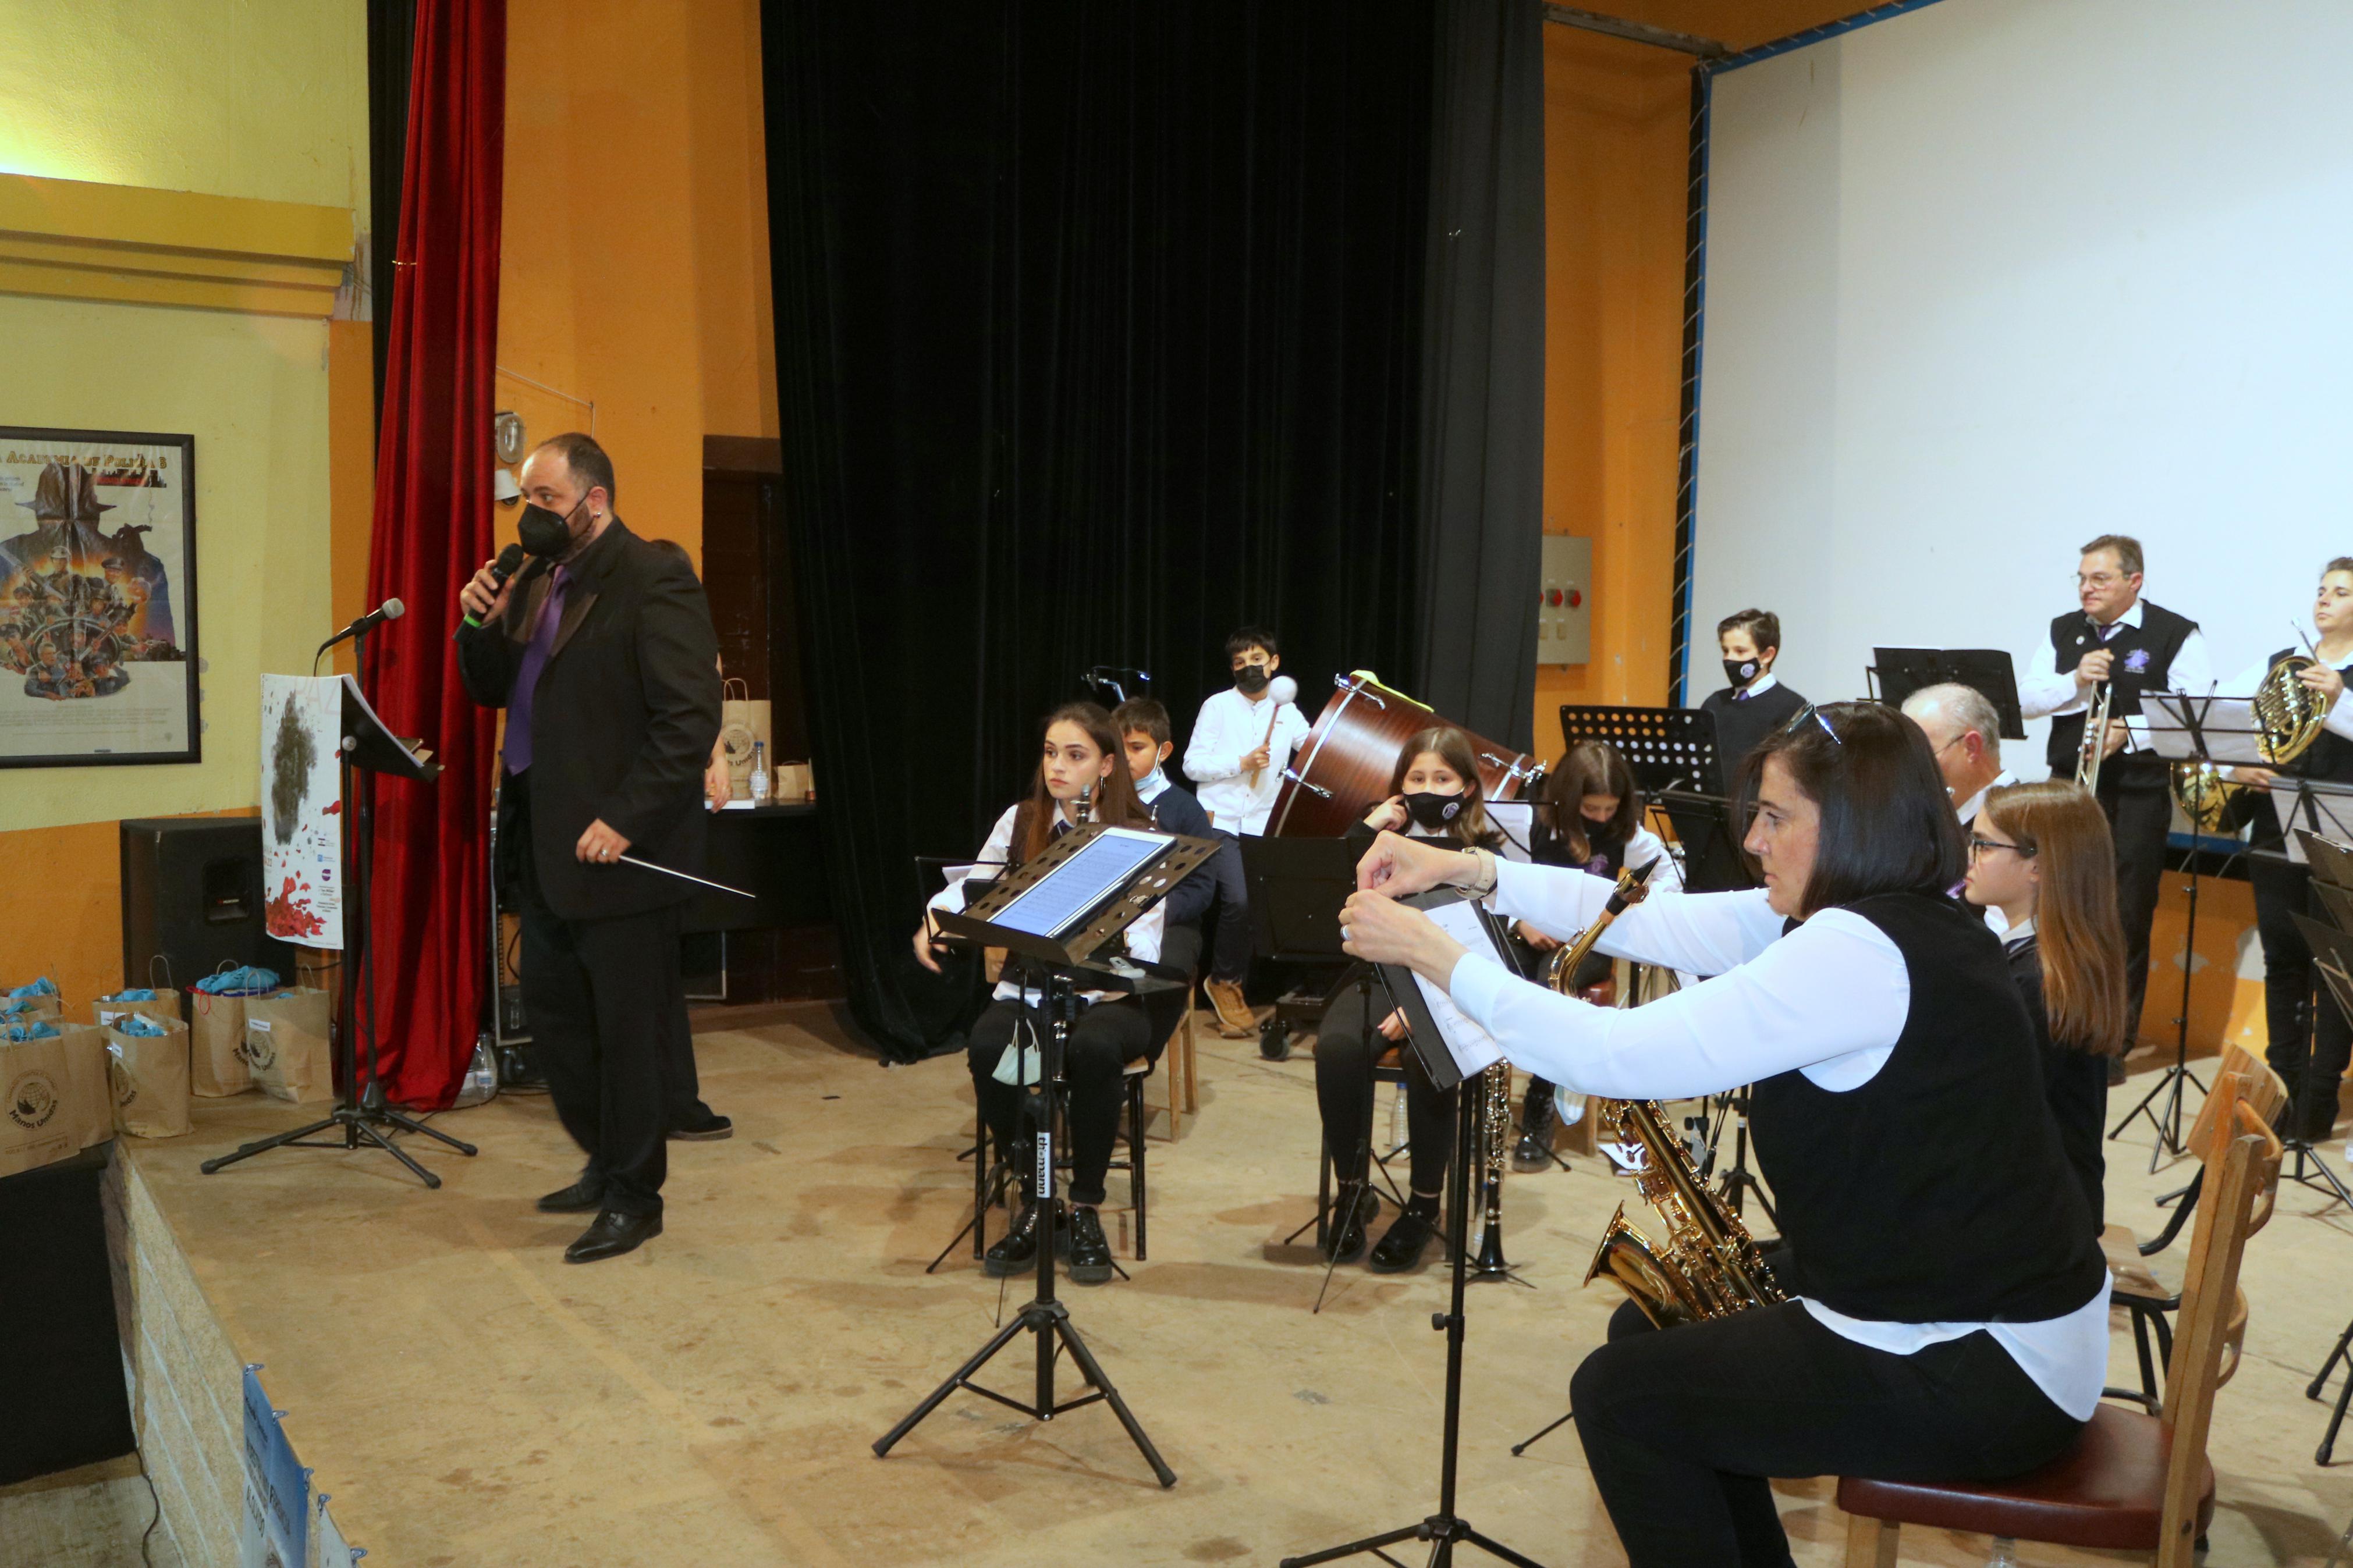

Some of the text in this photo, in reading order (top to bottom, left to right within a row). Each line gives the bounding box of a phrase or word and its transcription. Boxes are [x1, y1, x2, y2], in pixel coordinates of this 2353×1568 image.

[9, 1100, 58, 1129] Manos Unidas
[1038, 1137, 1048, 1194] thomann
